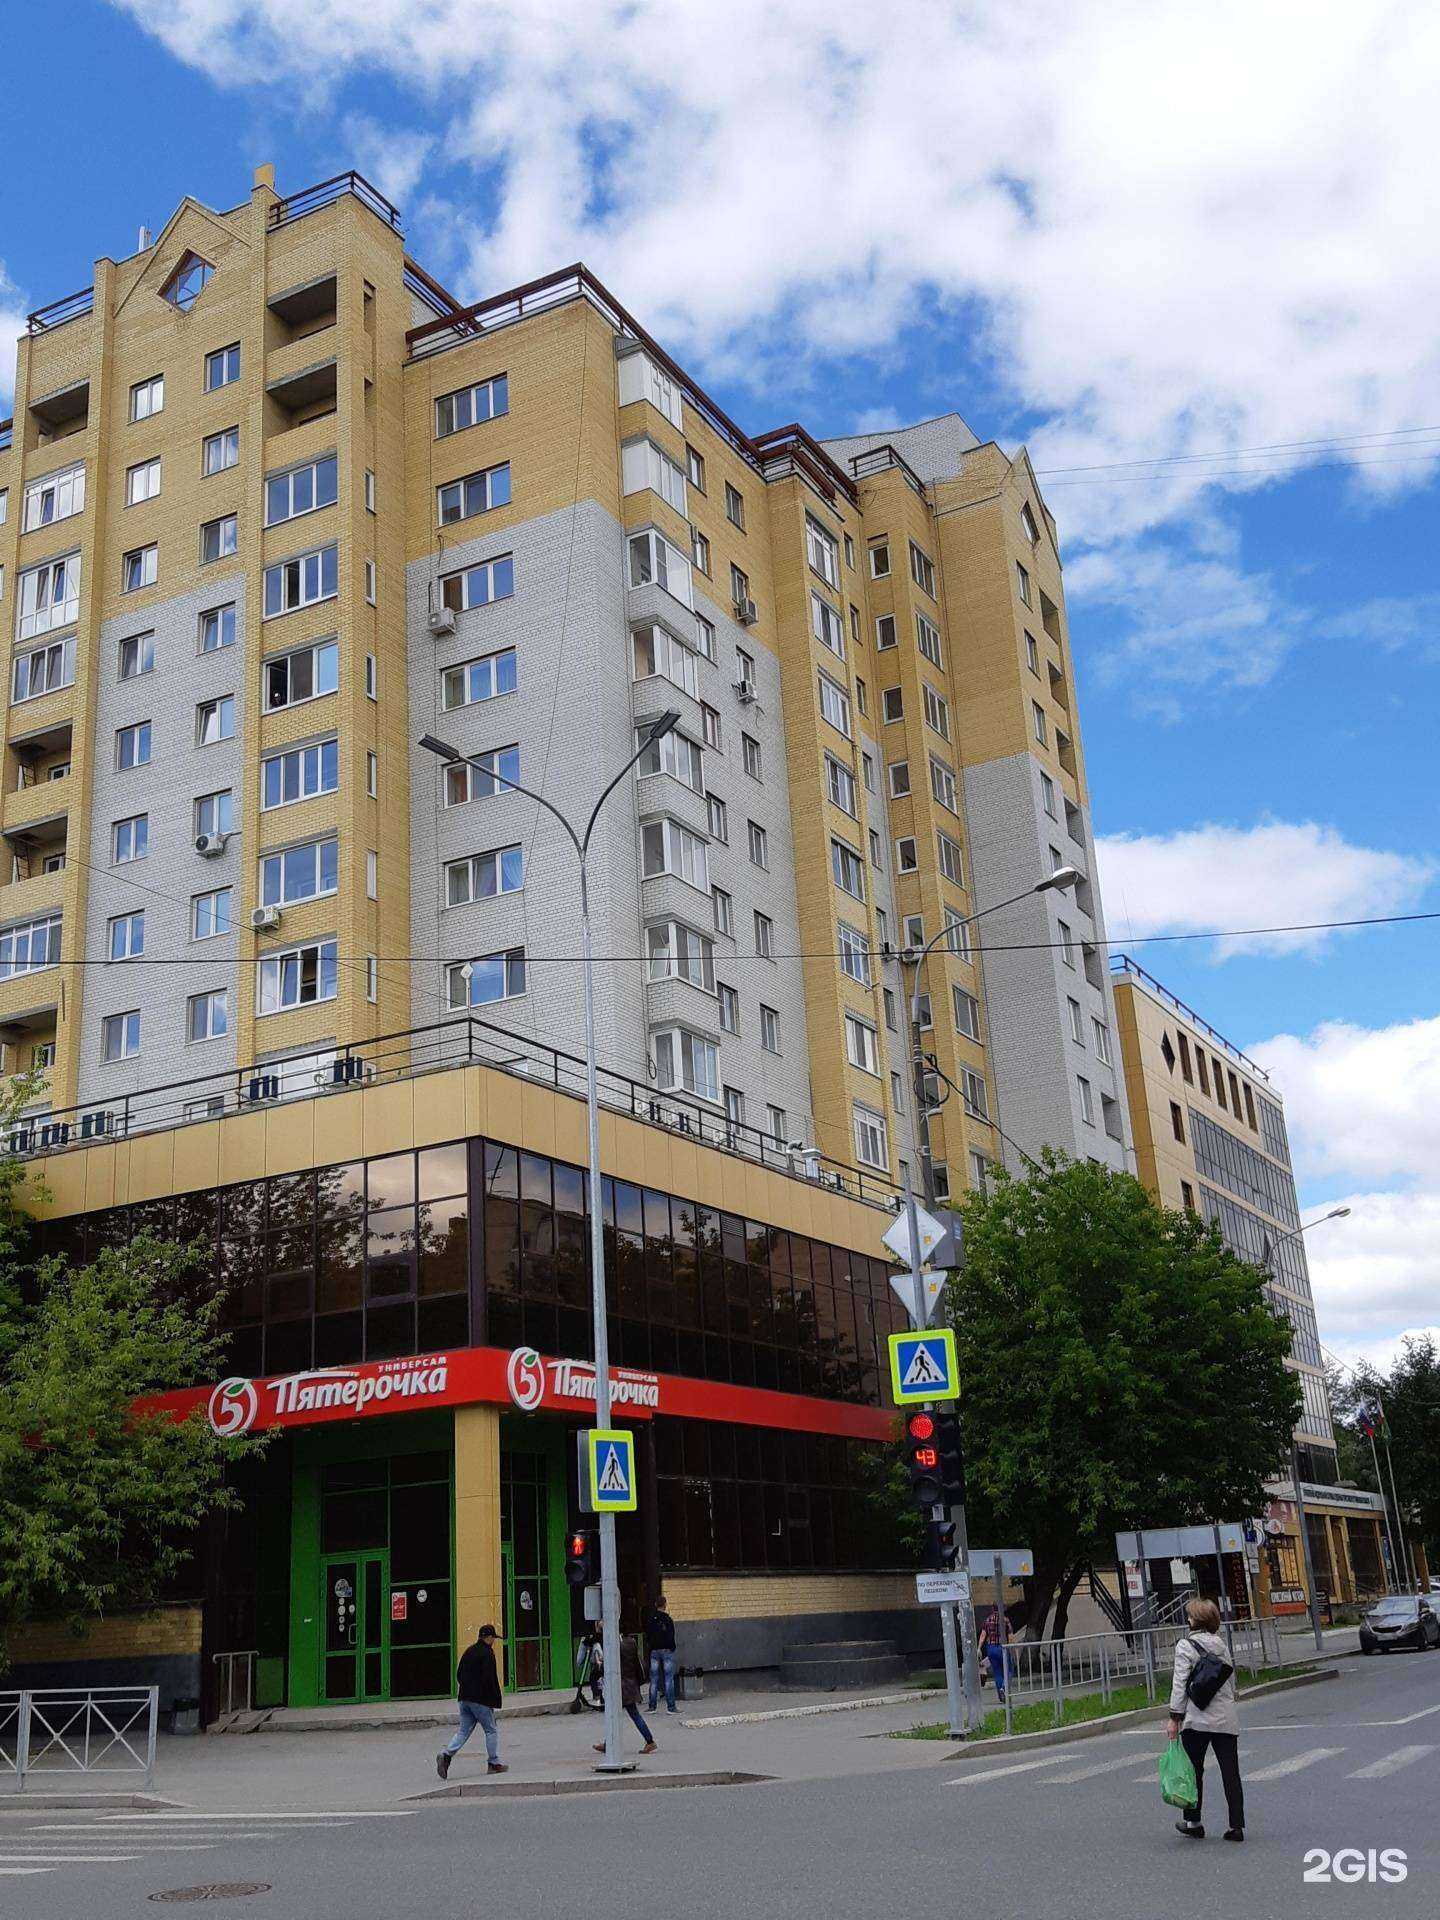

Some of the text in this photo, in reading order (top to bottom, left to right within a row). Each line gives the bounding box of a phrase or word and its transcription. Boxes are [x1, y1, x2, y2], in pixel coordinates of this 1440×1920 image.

[377, 1356, 447, 1373] УНИВЕРСАМ
[547, 1359, 660, 1408] Пятрочка
[618, 1371, 658, 1383] УНИВЕРСАМ
[267, 1366, 449, 1414] Пятерочка
[916, 1449, 936, 1465] 43
